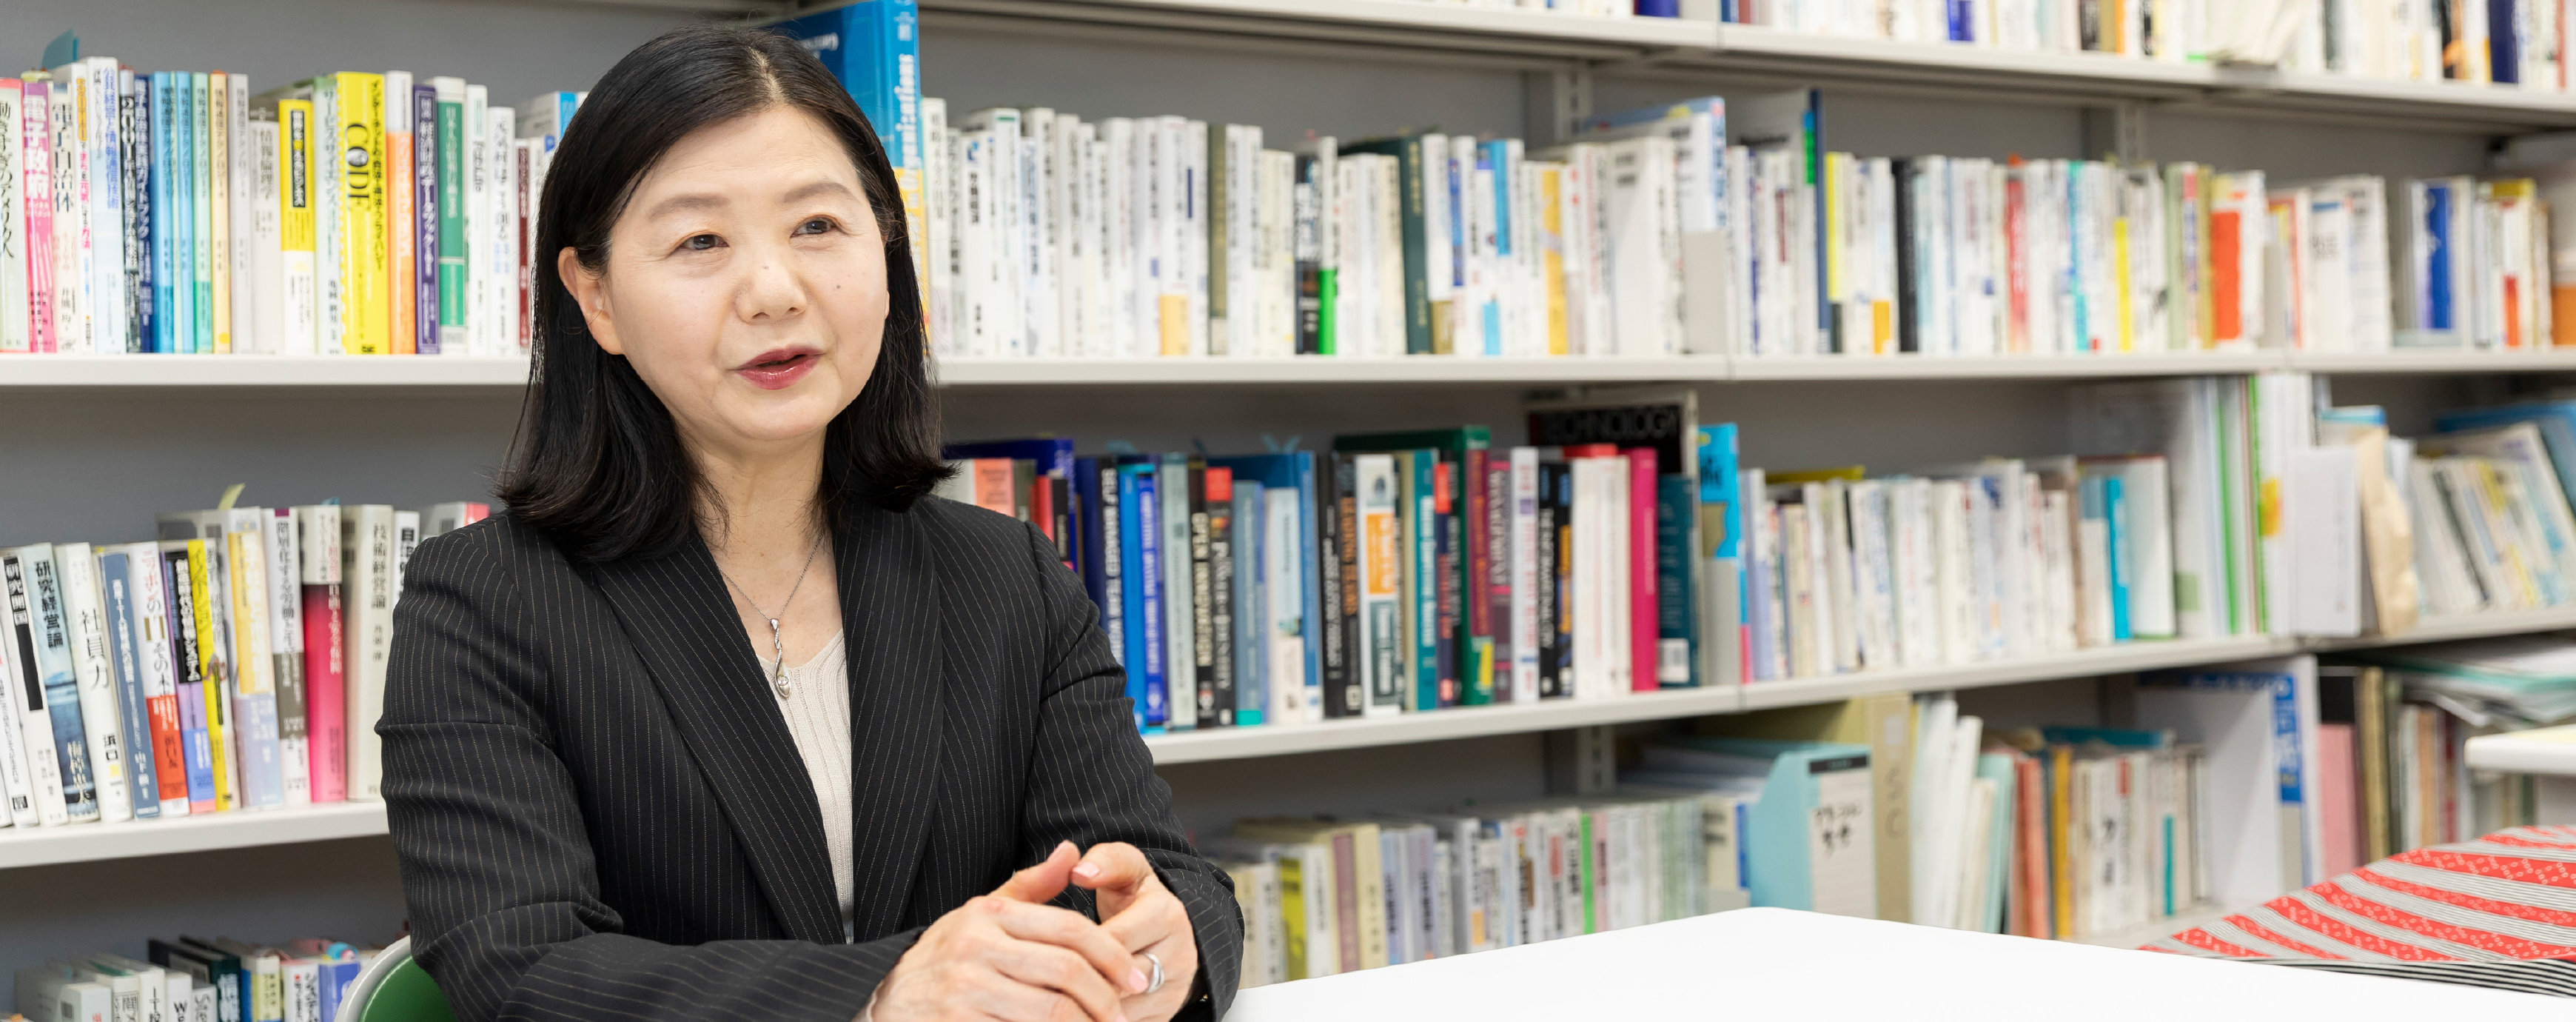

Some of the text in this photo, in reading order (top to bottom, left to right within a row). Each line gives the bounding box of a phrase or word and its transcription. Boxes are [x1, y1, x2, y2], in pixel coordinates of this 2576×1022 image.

[23, 94, 50, 200] 電子政府
[53, 104, 74, 213] 電子自治体
[344, 122, 371, 213] CODE
[34, 560, 64, 649] 研究経営論
[371, 522, 387, 609] 技術経営論
[1192, 512, 1213, 667] OPEN INNOVATION
[80, 608, 110, 691] 社員力
